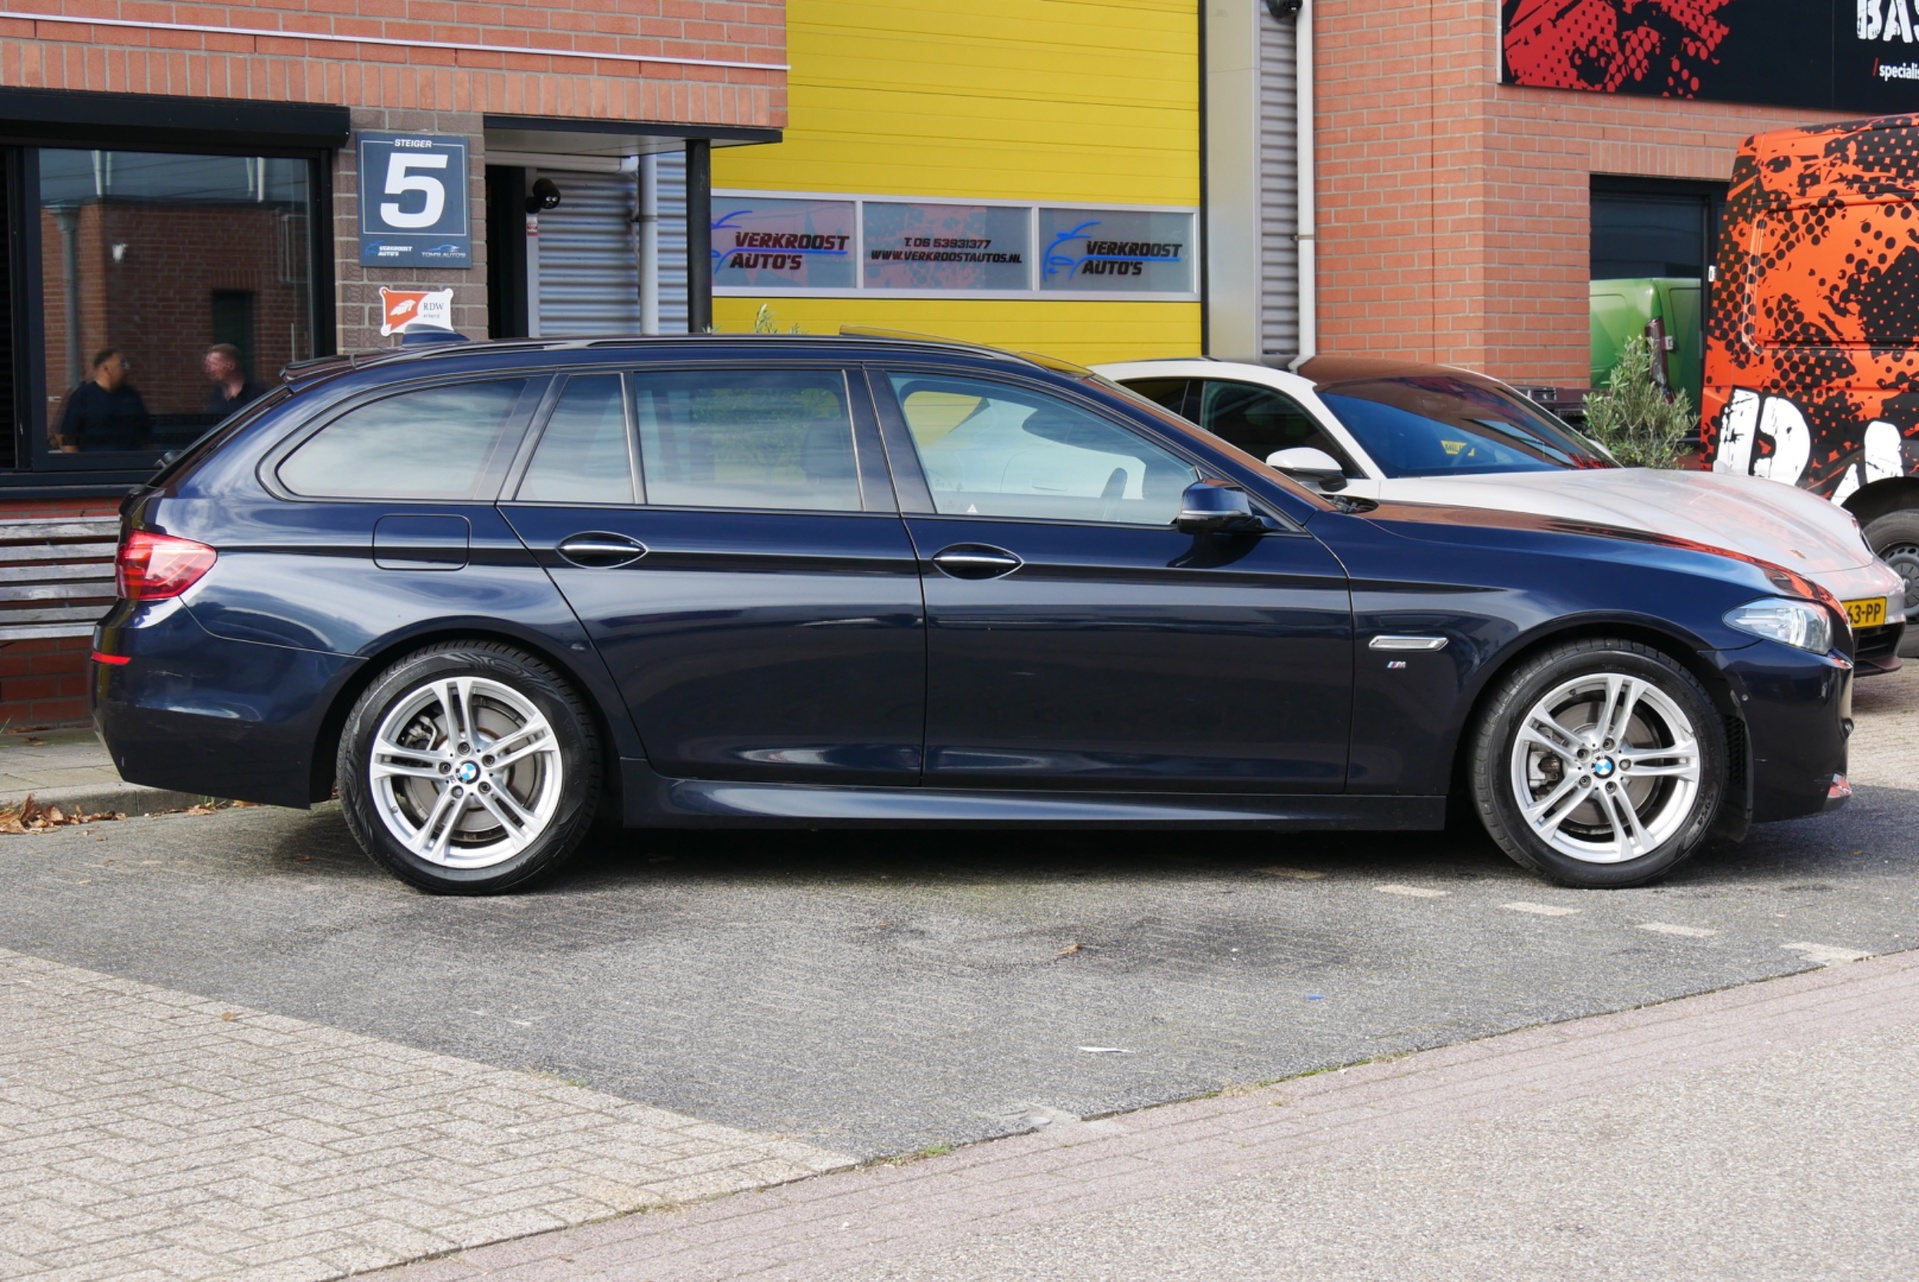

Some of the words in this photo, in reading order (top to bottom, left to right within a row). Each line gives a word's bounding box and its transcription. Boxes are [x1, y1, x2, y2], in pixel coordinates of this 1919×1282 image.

[1857, 0, 1919, 43] BA
[394, 139, 432, 148] STEIGER
[380, 153, 448, 228] 5
[735, 231, 850, 250] VERKROOST
[914, 238, 930, 248] 06
[1086, 240, 1183, 257] VERKROOST
[729, 253, 803, 270] AUTO'S
[871, 250, 1022, 263] WWW.VERKROOSTAUTOS.NL
[1082, 260, 1143, 275] AUTO'S
[423, 302, 444, 312] RDW
